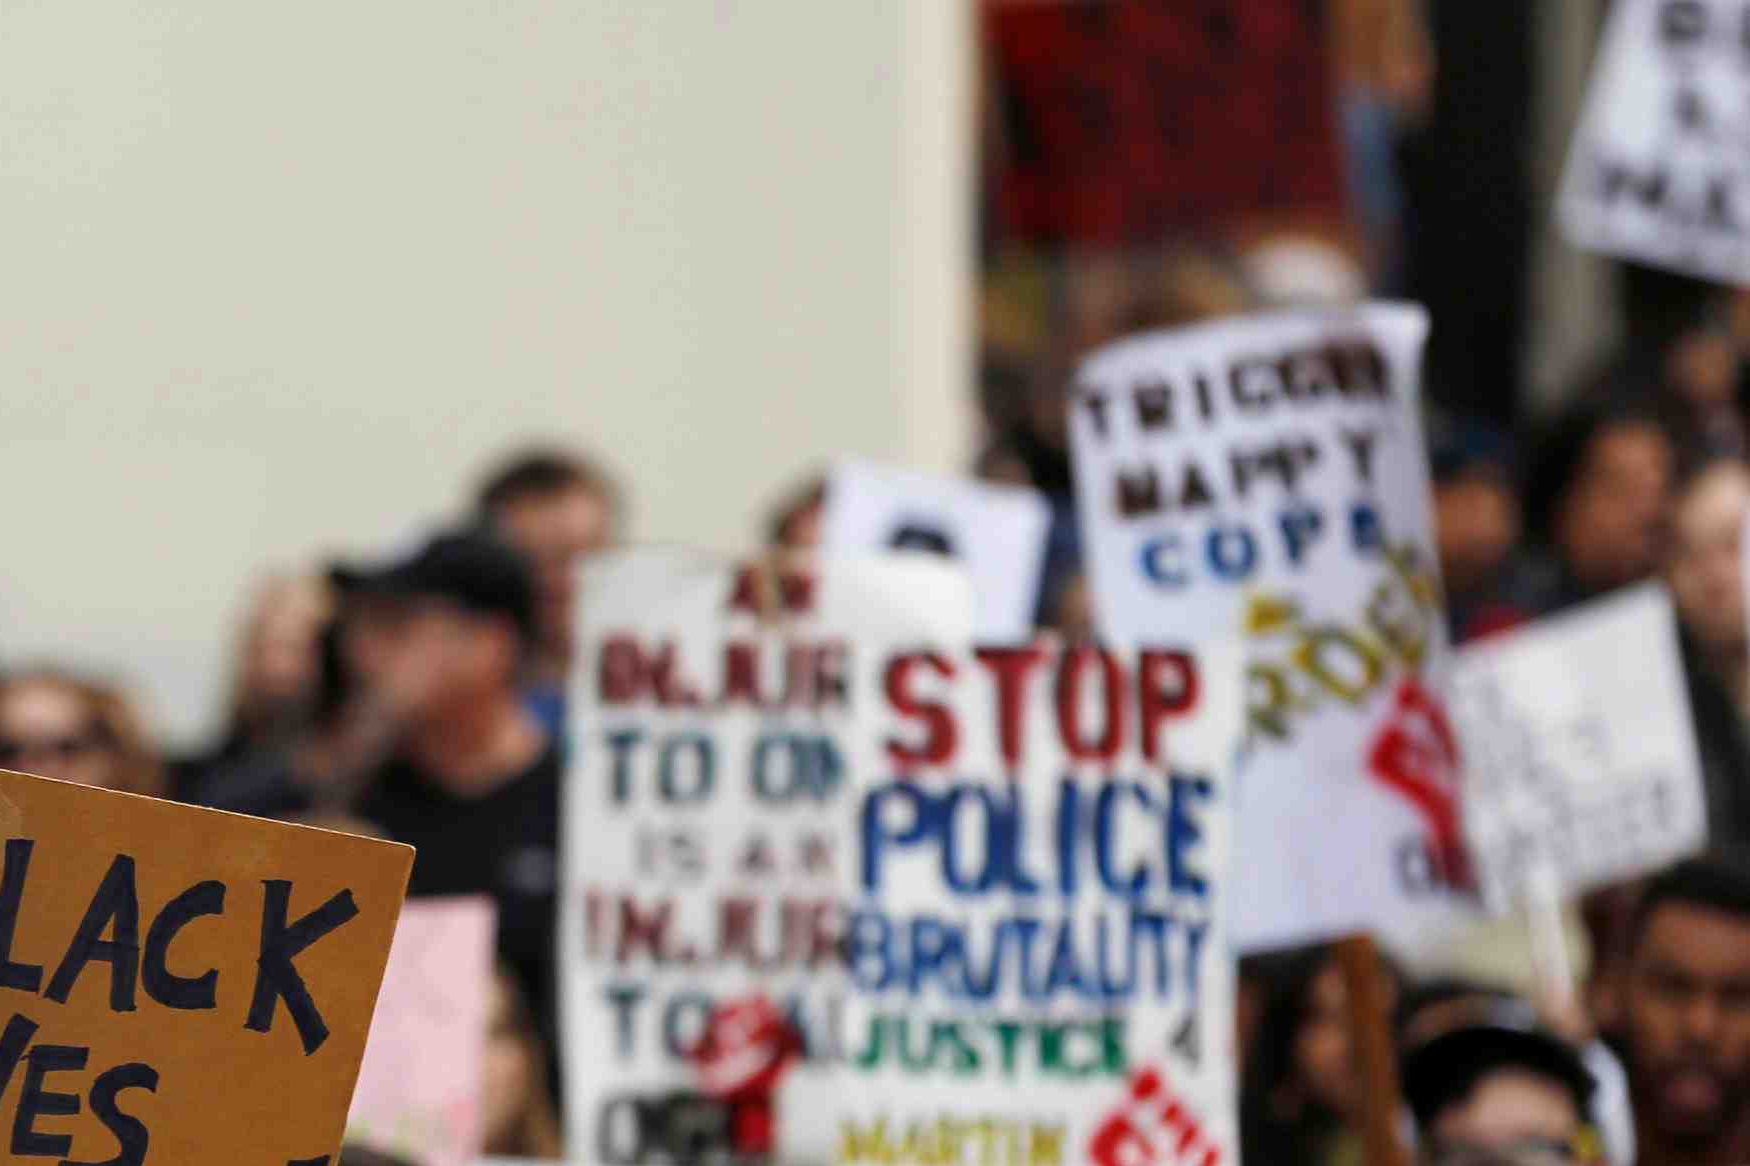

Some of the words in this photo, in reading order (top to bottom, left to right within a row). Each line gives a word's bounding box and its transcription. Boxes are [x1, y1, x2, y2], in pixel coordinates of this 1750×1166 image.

[884, 642, 1202, 770] STOP
[604, 726, 716, 806] TO
[860, 772, 1212, 898] POLICE
[850, 906, 1212, 1004] BRUTALITY
[852, 1016, 1130, 1078] JUSTICE
